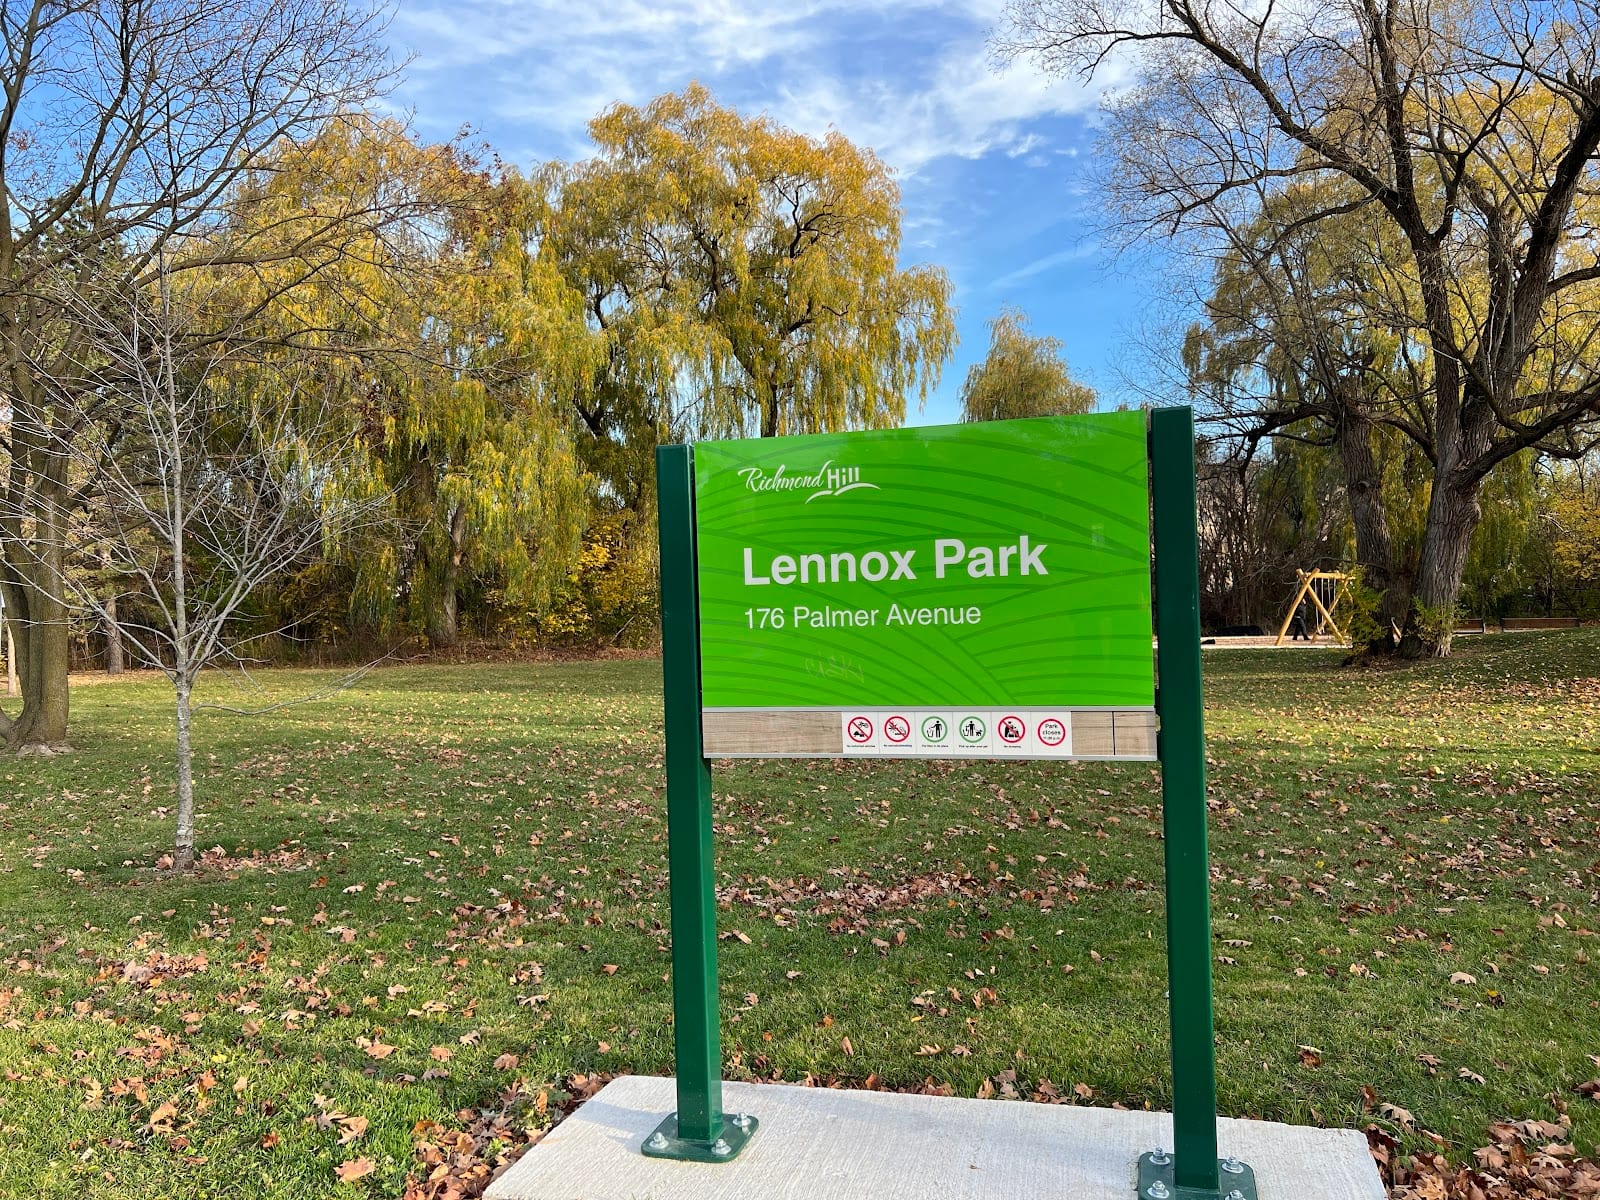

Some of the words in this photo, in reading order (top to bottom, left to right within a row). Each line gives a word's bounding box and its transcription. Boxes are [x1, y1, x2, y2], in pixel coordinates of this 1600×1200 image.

[738, 460, 834, 492] Richmond
[827, 467, 860, 489] Hill
[743, 547, 917, 586] Lennox
[934, 535, 1049, 579] Park
[744, 607, 785, 629] 176
[793, 605, 879, 628] Palmer
[886, 603, 981, 626] Avenue
